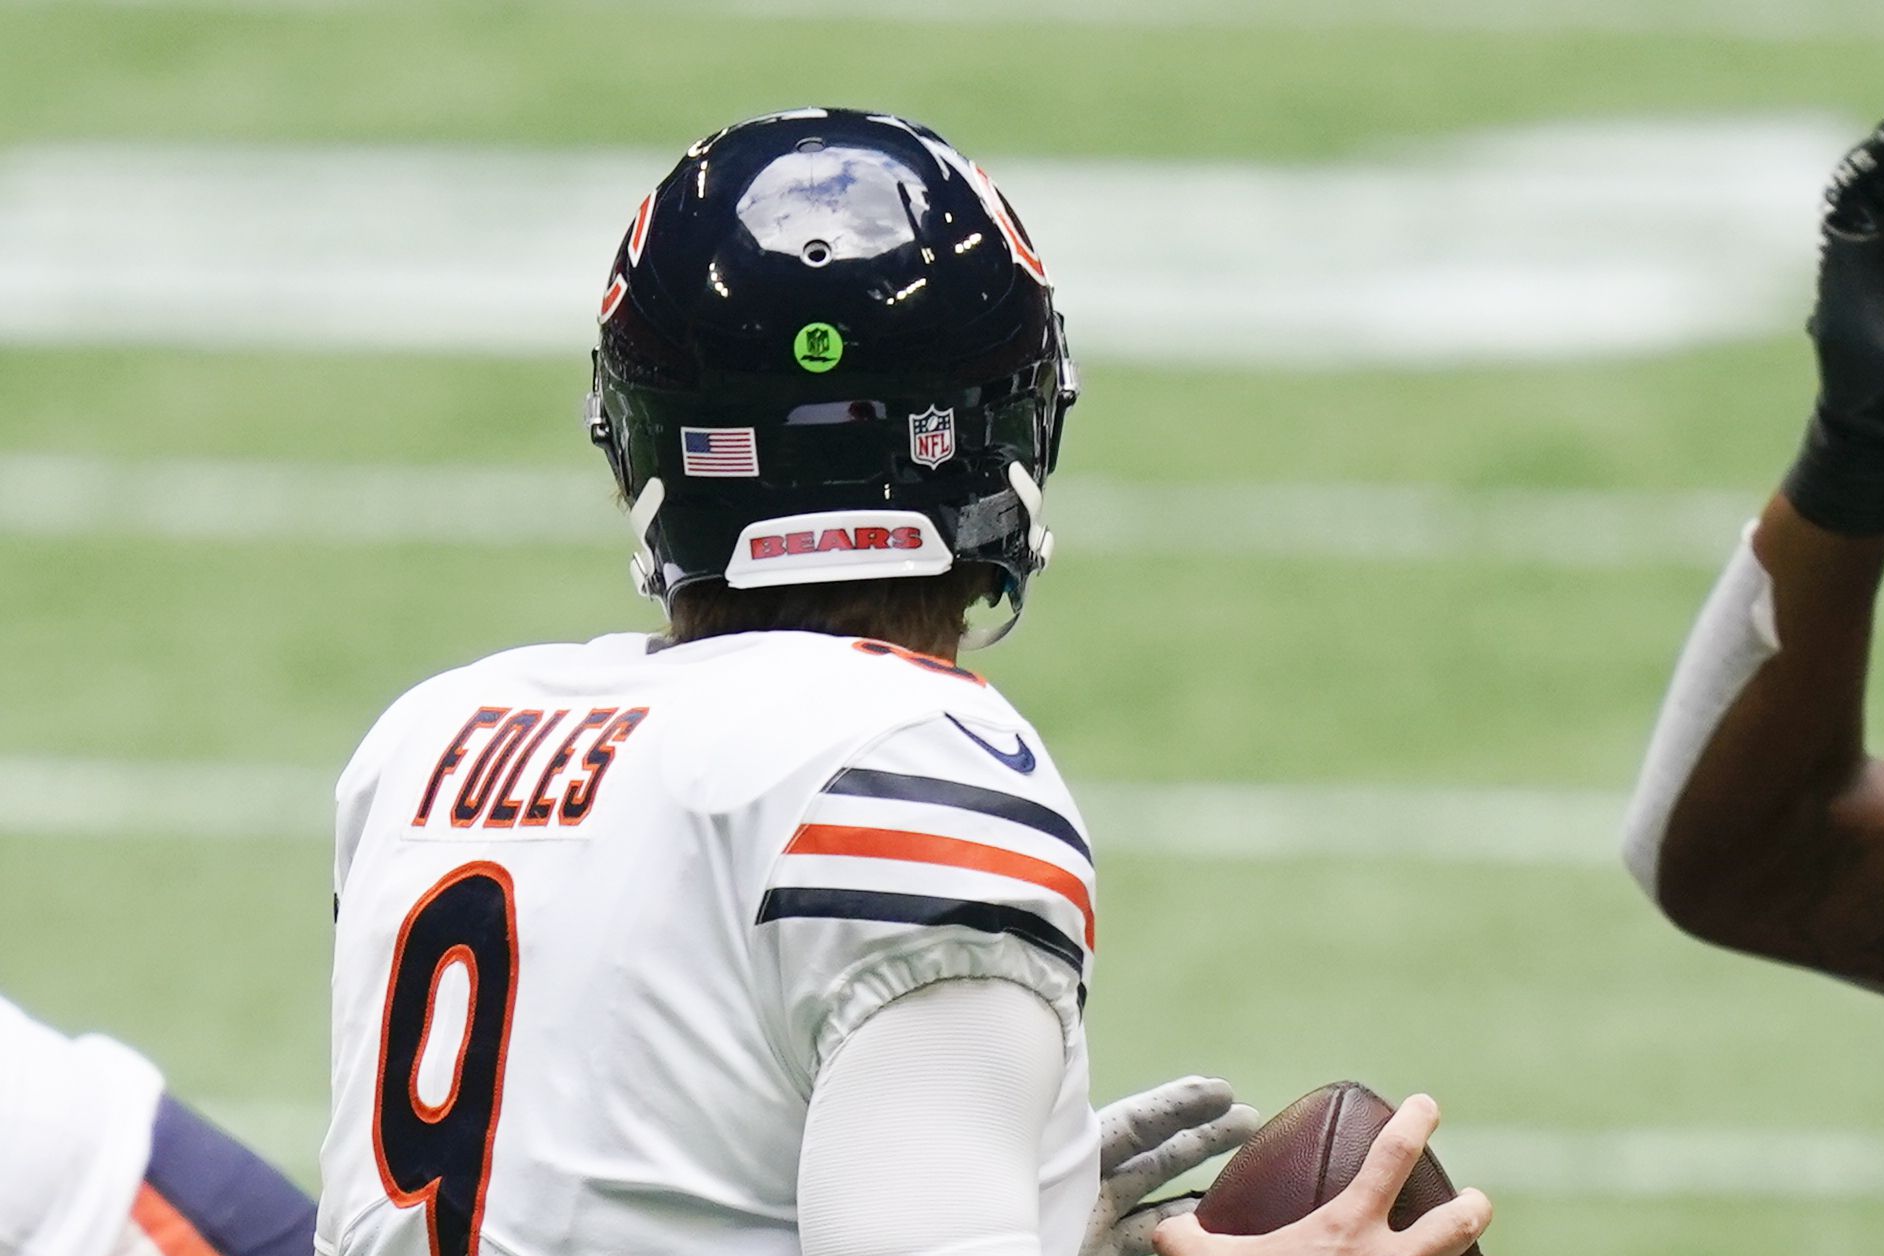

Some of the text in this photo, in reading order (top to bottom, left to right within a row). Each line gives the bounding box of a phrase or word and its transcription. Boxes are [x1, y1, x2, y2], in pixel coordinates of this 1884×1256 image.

[917, 432, 951, 459] NFL
[749, 526, 924, 560] BEARS
[411, 706, 650, 829] FOLES
